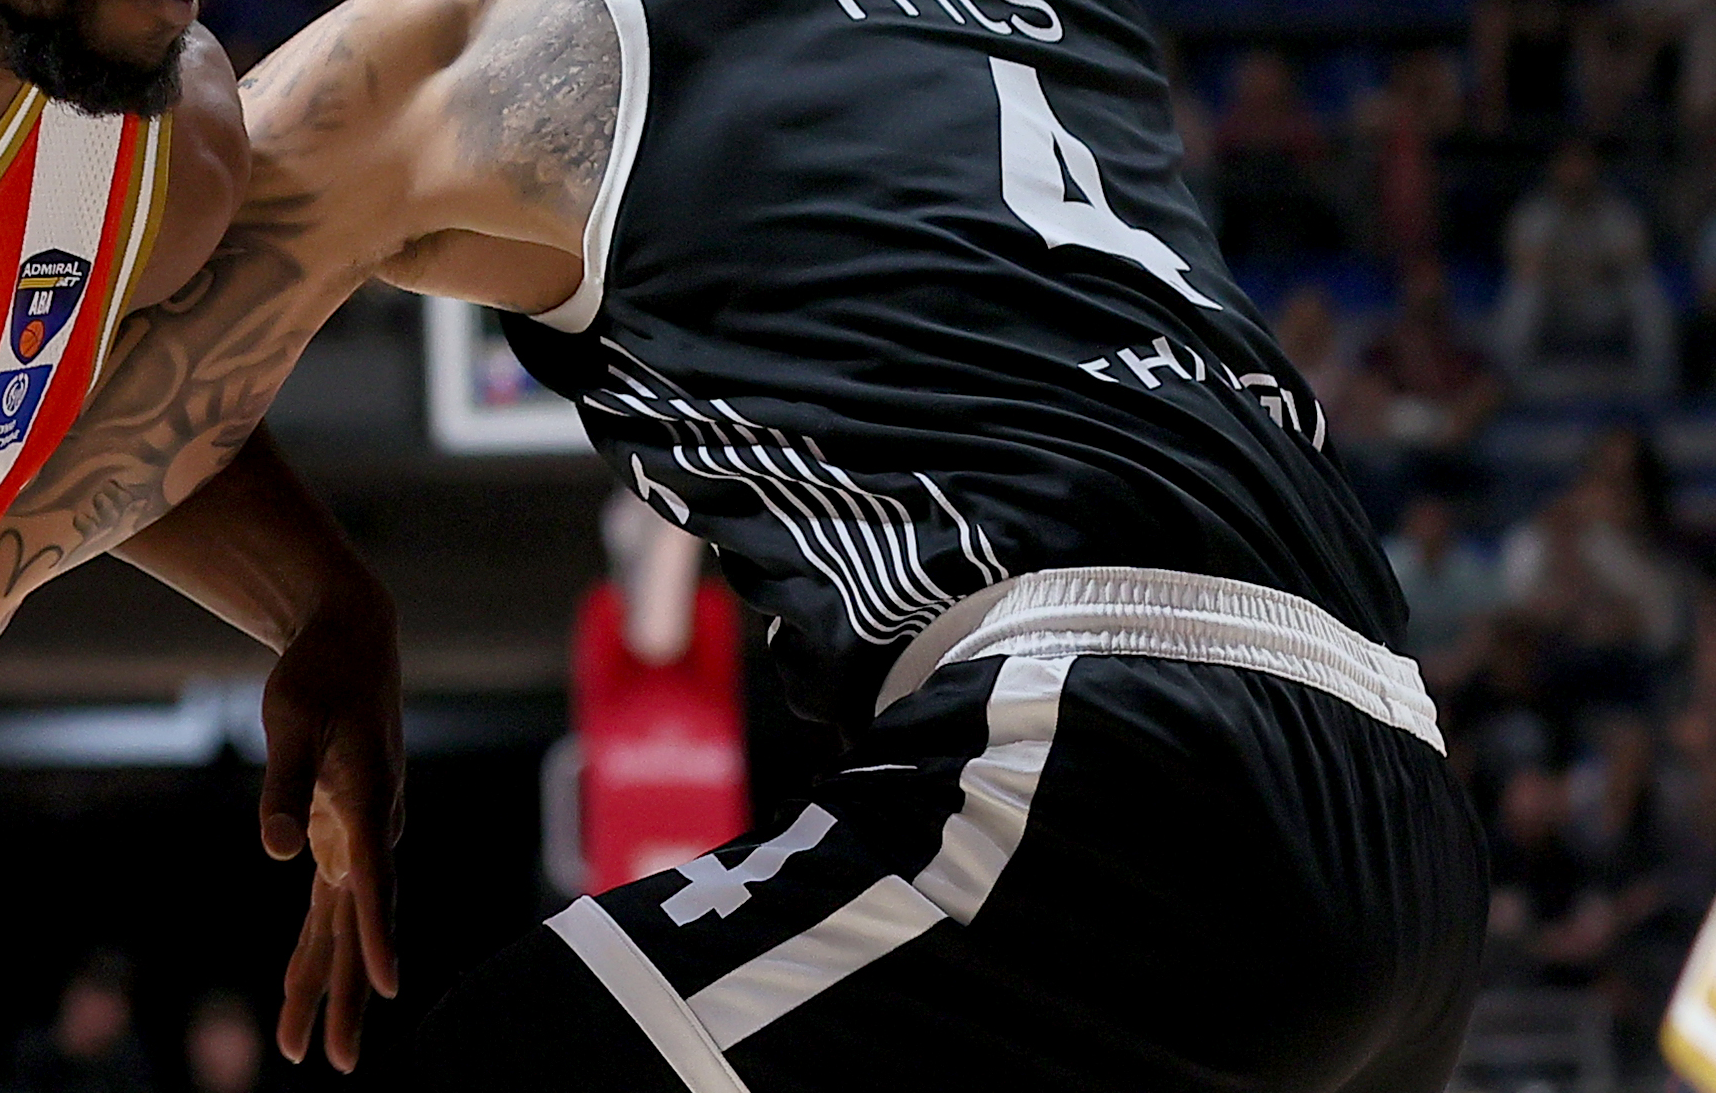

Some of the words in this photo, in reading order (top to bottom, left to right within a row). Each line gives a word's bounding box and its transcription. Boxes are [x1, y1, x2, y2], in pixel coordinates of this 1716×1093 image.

[988, 56, 1222, 310] 4
[22, 261, 82, 277] ADMIRAL
[28, 290, 54, 316] ABA
